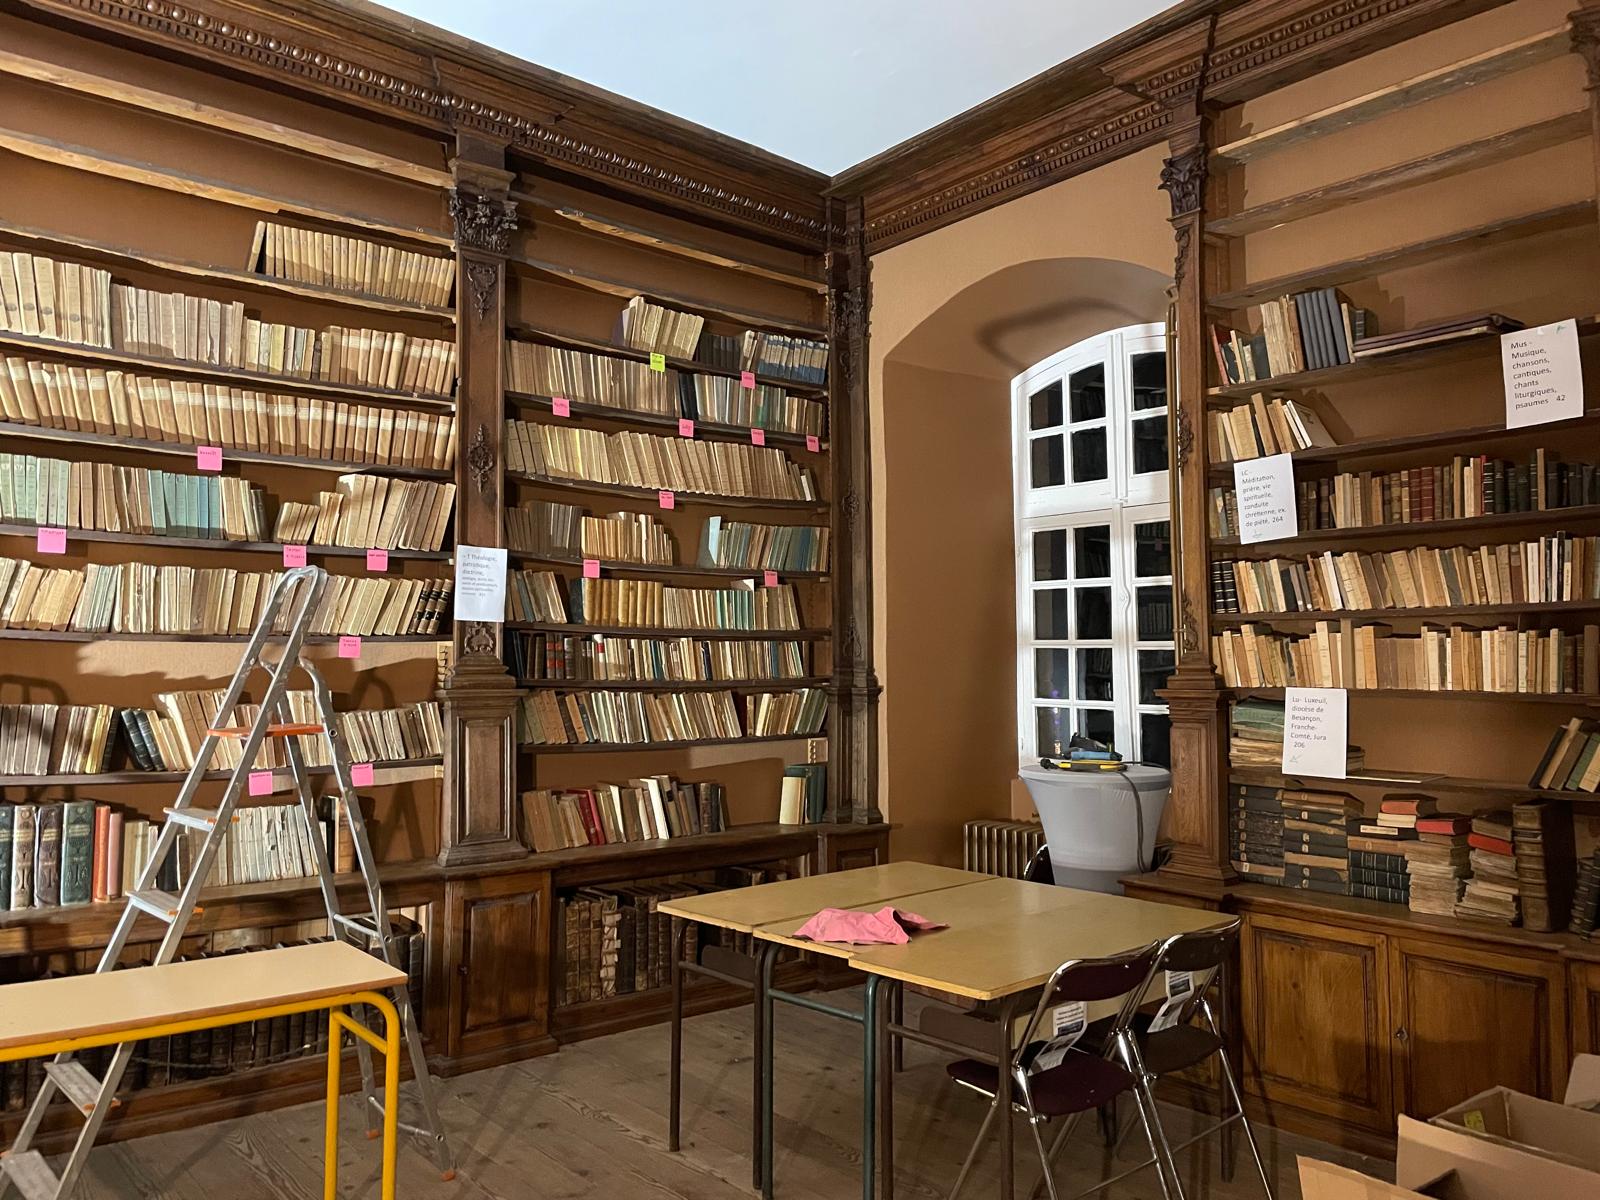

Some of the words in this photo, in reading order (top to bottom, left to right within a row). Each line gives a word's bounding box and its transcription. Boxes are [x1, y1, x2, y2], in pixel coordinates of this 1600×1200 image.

[1512, 348, 1546, 359] Musique,
[1512, 358, 1550, 369] chansons,
[1513, 369, 1552, 379] cantiques,
[1514, 380, 1539, 389] chants
[1515, 388, 1557, 399] liturgiques,
[1515, 399, 1549, 410] psaumes
[1242, 474, 1275, 484] Méditation,
